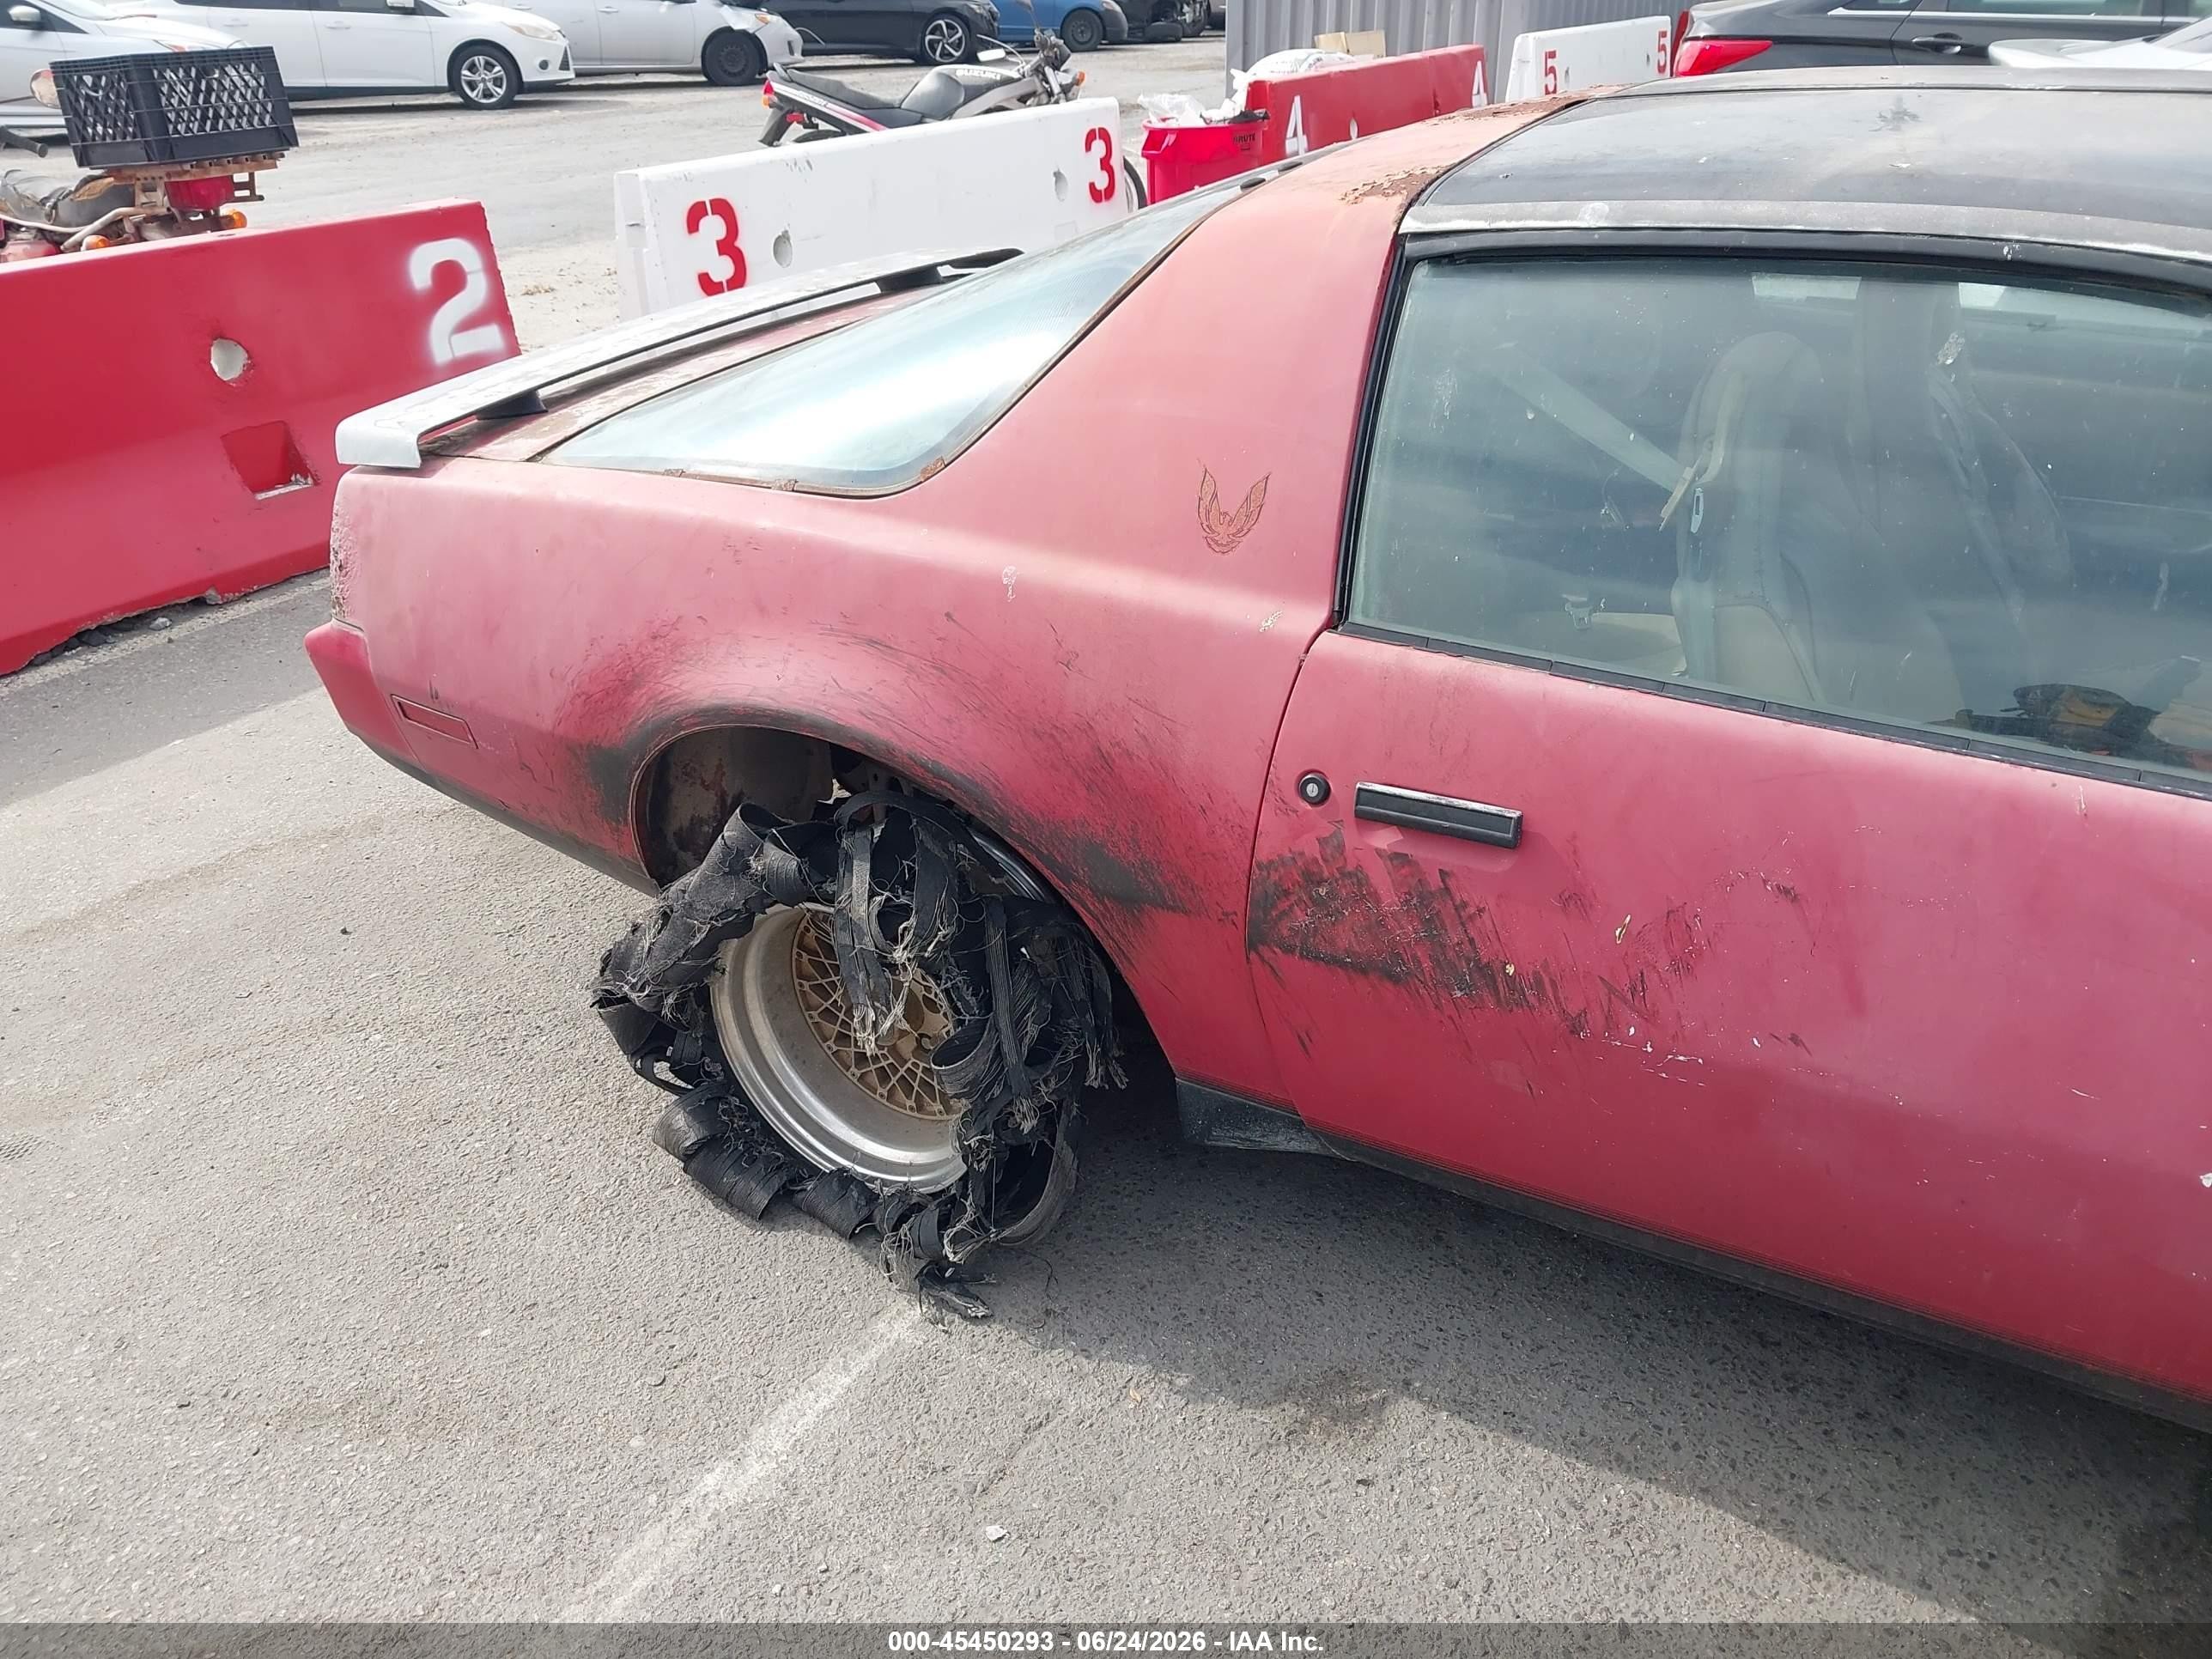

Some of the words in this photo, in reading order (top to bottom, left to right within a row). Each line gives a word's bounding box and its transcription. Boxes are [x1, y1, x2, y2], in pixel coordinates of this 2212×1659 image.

[955, 69, 1001, 81] SUZUKI
[1544, 50, 1558, 94] 5
[1656, 30, 1668, 75] 5
[1472, 60, 1488, 108] 4
[1285, 95, 1309, 155] 4
[1085, 127, 1116, 203] 3
[686, 198, 748, 296] 3
[409, 237, 505, 366] 2
